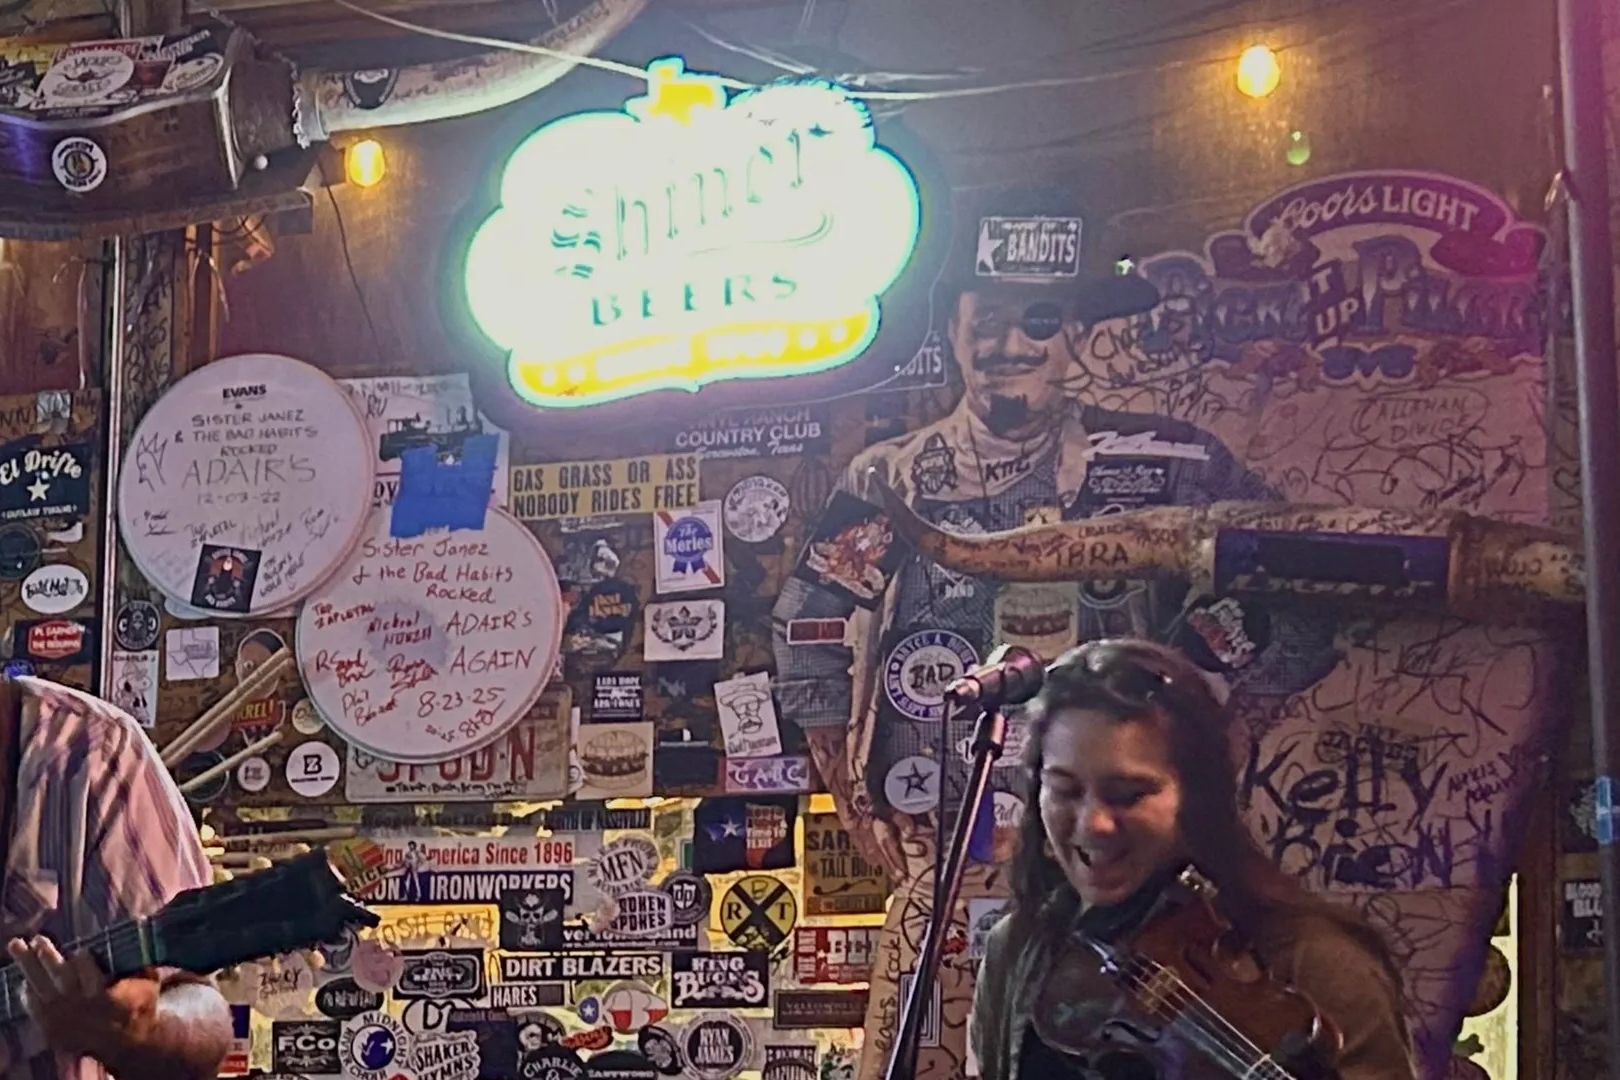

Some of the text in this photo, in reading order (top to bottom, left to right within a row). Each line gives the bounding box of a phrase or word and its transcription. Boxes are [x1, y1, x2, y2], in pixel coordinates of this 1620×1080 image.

[1281, 184, 1479, 231] Coors LIGHT
[1006, 233, 1076, 263] BANDITS
[222, 385, 266, 399] EVANS
[192, 409, 305, 427] SISTER JANEZ
[192, 426, 318, 443] THE BAD HABITS
[675, 422, 822, 447] COUNTRY CLUB
[768, 440, 804, 456] Texas
[181, 453, 316, 489] ADAIR'S
[513, 456, 697, 492] GAS GRASS OR ASS
[514, 483, 697, 518] NOBODY RIDES FREE
[363, 538, 489, 558] Sister Janez
[664, 536, 712, 554] Merles
[380, 561, 512, 583] the Bad Habits
[426, 584, 496, 603] Rocked
[446, 609, 532, 636] ADAIR'S
[450, 646, 536, 676] AGAIN
[910, 663, 956, 688] BAD
[485, 843, 528, 864] Since
[534, 841, 573, 865] 1896
[600, 851, 643, 881] MFN
[727, 903, 792, 920] R T
[506, 956, 661, 978] DIRT BLAZERS
[492, 986, 537, 1006] HARES
[362, 1013, 408, 1068] MIDNIGHT
[700, 1028, 729, 1044] RYAN
[416, 1040, 470, 1072] SHAKER
[696, 1046, 735, 1065] JAMES
[523, 1057, 583, 1078] CHARLIE
